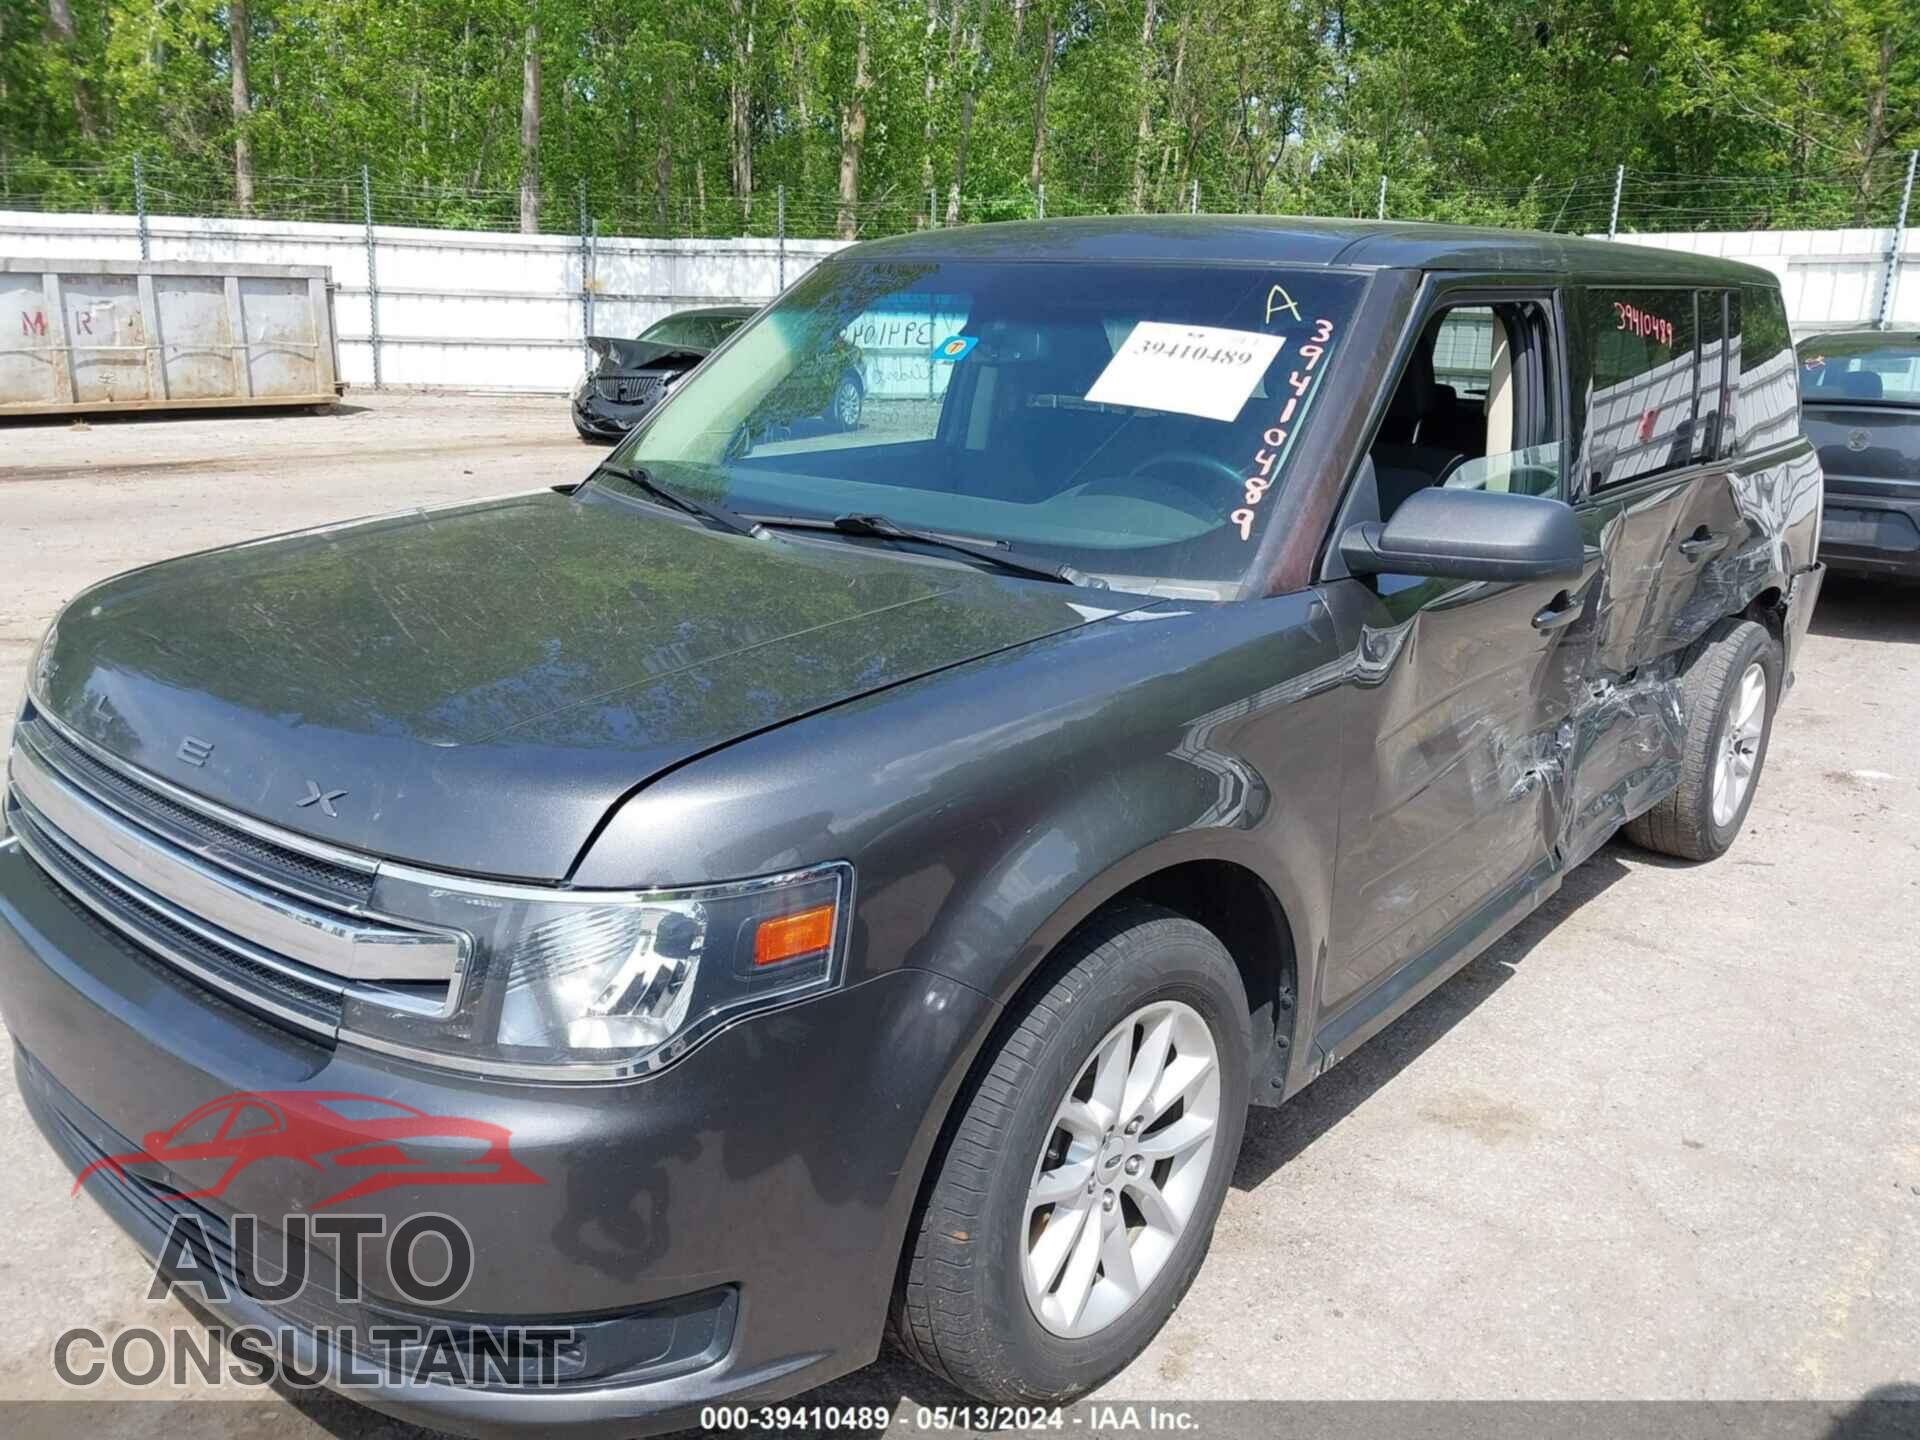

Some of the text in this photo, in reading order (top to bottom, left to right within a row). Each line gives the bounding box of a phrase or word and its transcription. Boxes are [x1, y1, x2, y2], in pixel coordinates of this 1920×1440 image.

[1265, 284, 1302, 324] A
[21, 311, 48, 336] M
[1614, 302, 1672, 348] 39410489
[1142, 339, 1253, 364] 39410489
